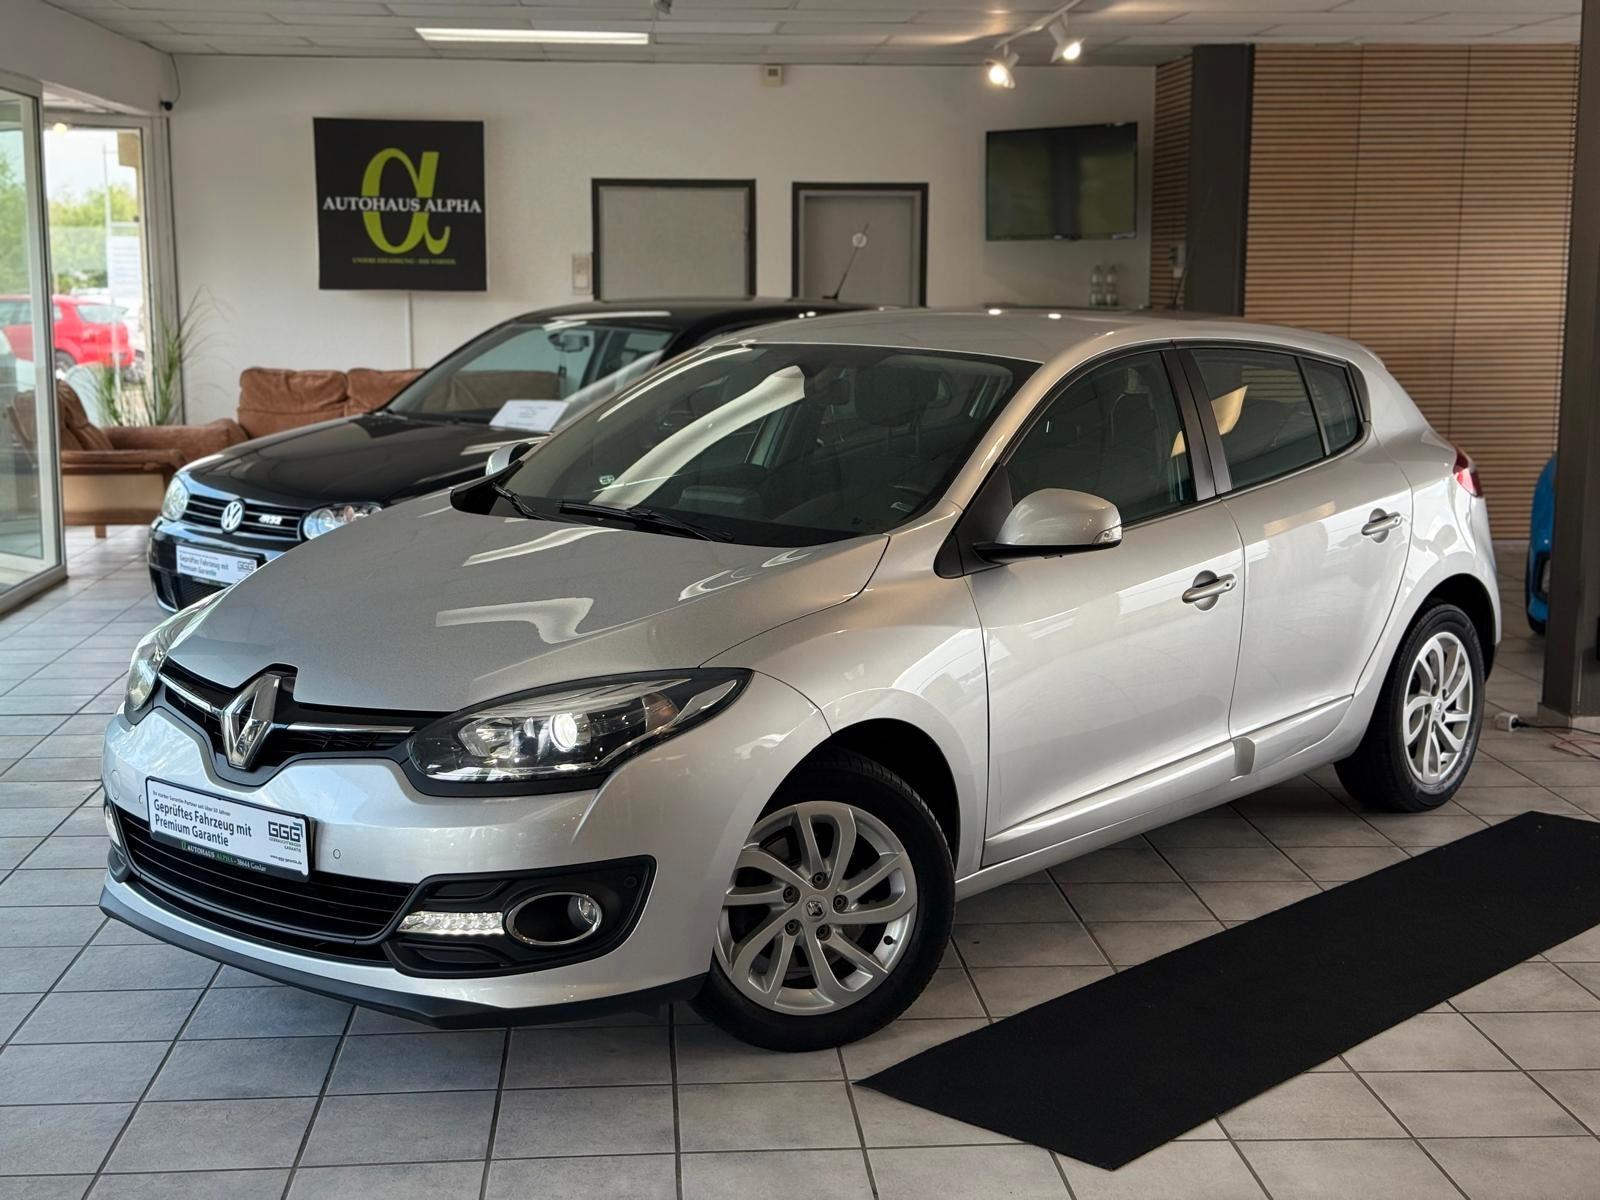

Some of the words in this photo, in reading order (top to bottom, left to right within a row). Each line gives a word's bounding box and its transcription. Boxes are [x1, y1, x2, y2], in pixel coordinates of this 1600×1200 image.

[323, 196, 421, 212] AUTOHAUS
[424, 198, 482, 213] ALPHA
[153, 799, 193, 822] Geprüftes
[194, 810, 235, 836] Fahrzeug
[236, 823, 252, 837] mit
[155, 814, 191, 835] Premium
[192, 826, 229, 847] Garantie
[268, 821, 301, 843] GGG
[187, 845, 215, 858] AUTOHAUS
